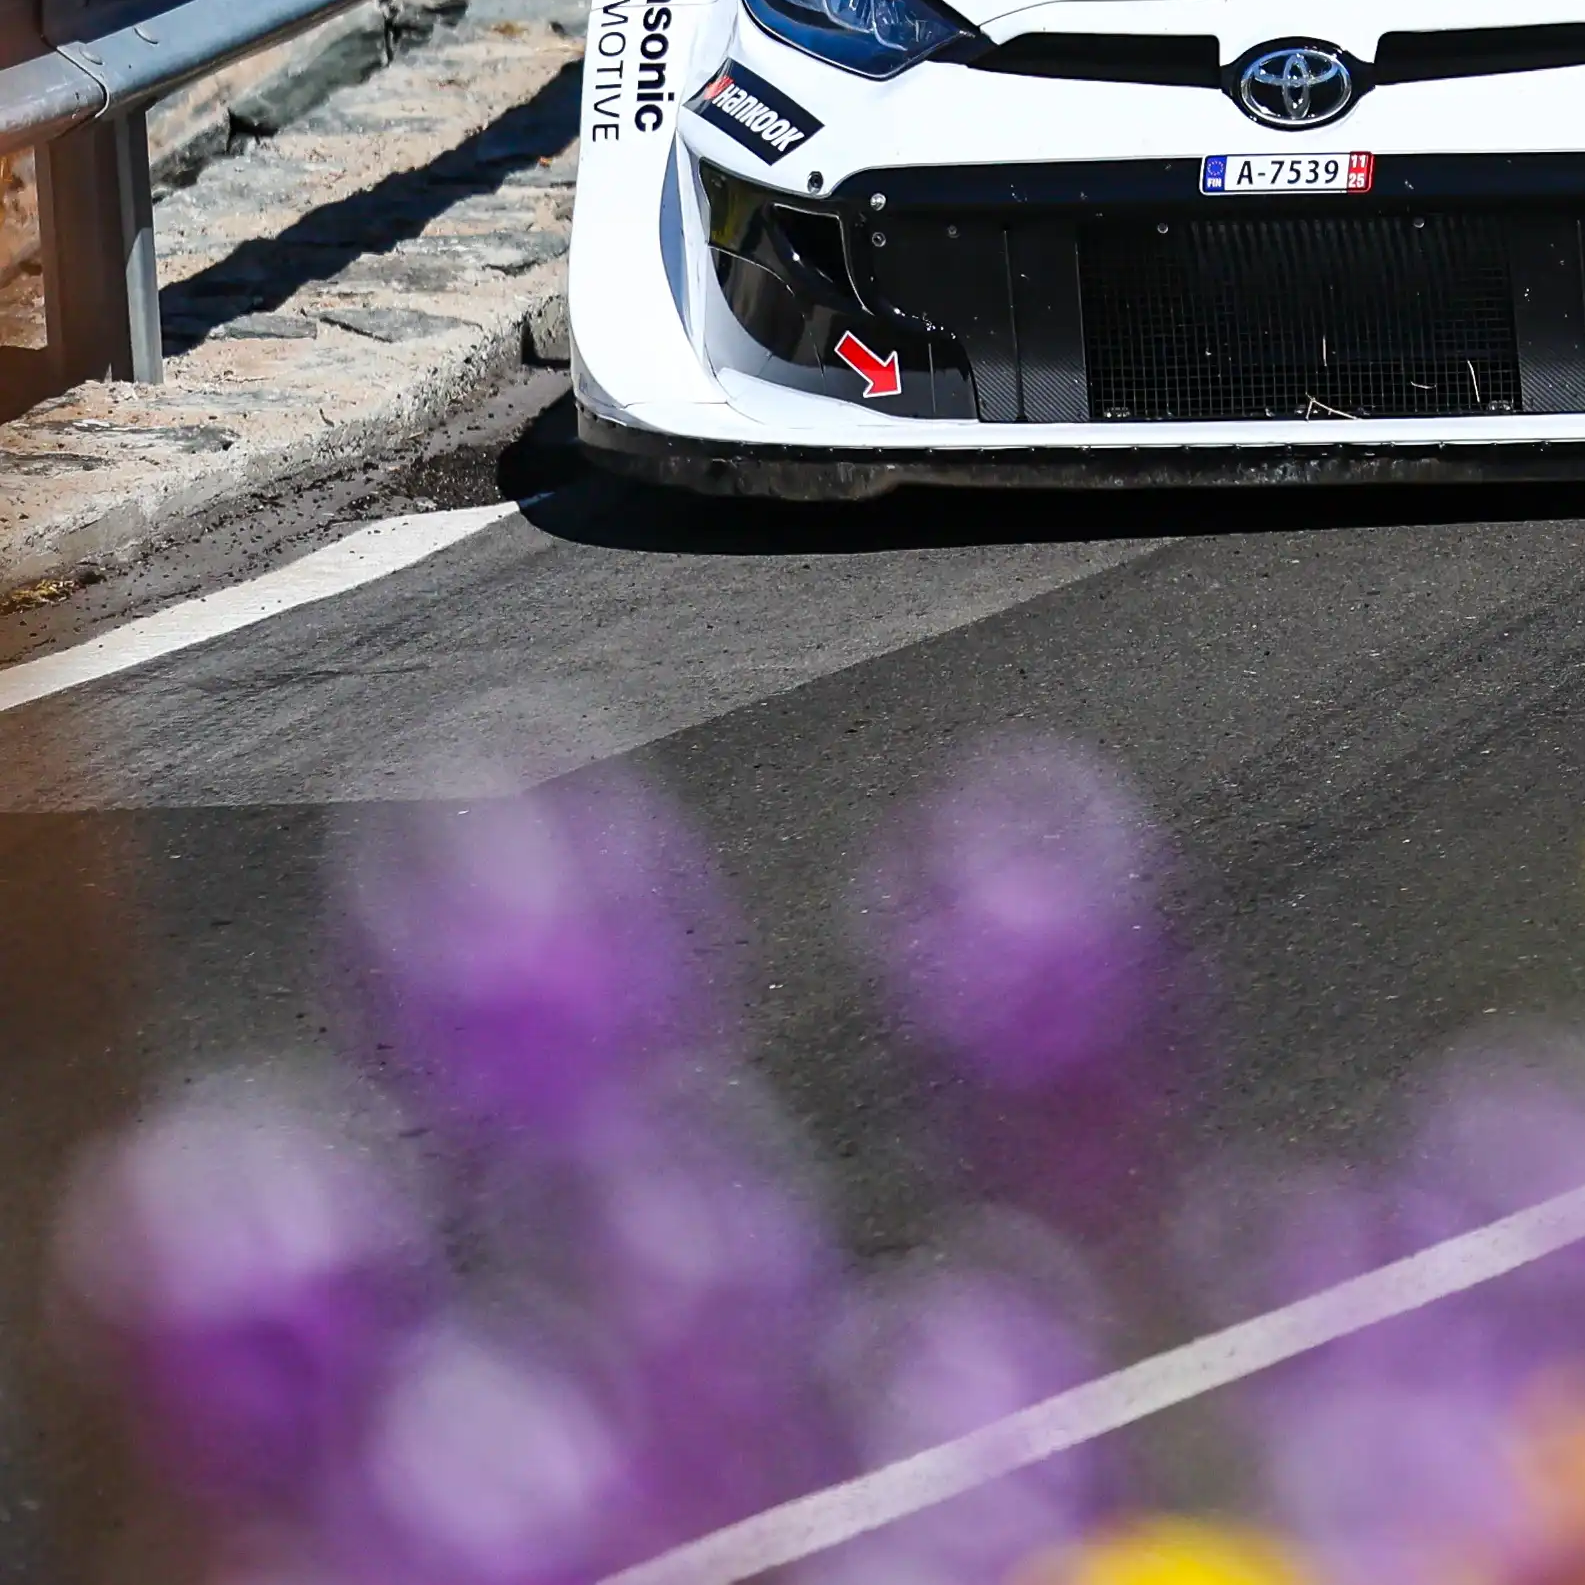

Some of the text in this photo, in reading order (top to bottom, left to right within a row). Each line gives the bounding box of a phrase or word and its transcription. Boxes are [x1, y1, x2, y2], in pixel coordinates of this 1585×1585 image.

[1350, 154, 1367, 168] 11
[1236, 159, 1340, 185] A-7539
[1206, 177, 1222, 188] FIN
[1348, 172, 1366, 189] 25
